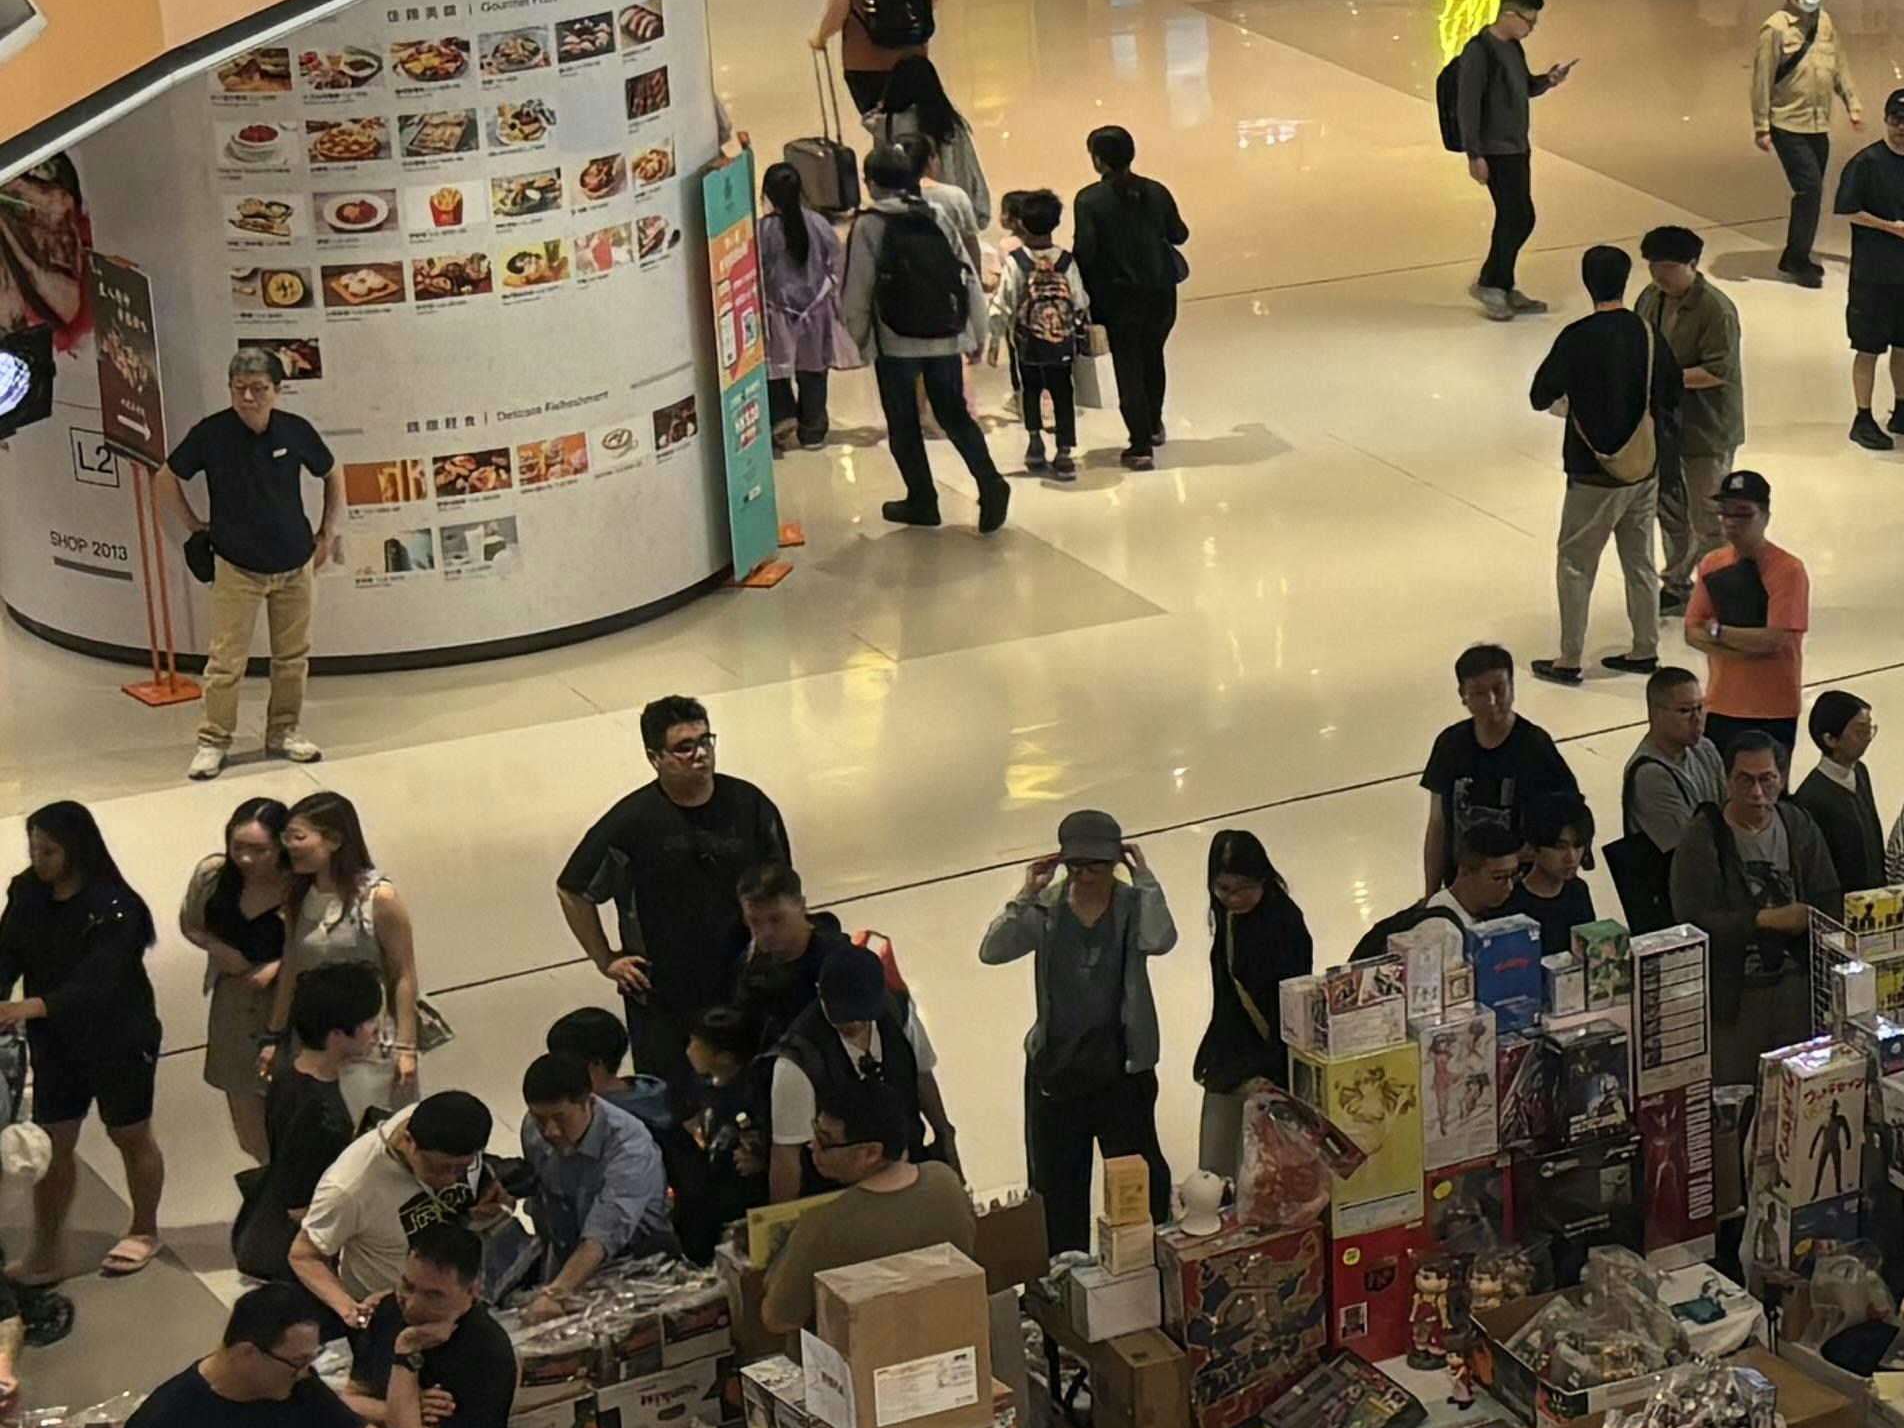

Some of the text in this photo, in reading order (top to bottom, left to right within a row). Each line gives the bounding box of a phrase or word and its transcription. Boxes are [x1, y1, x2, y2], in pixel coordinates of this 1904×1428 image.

[76, 439, 114, 474] L2
[50, 530, 88, 554] SHOP
[1684, 1077, 1714, 1221] ULTRAMAN TARO
